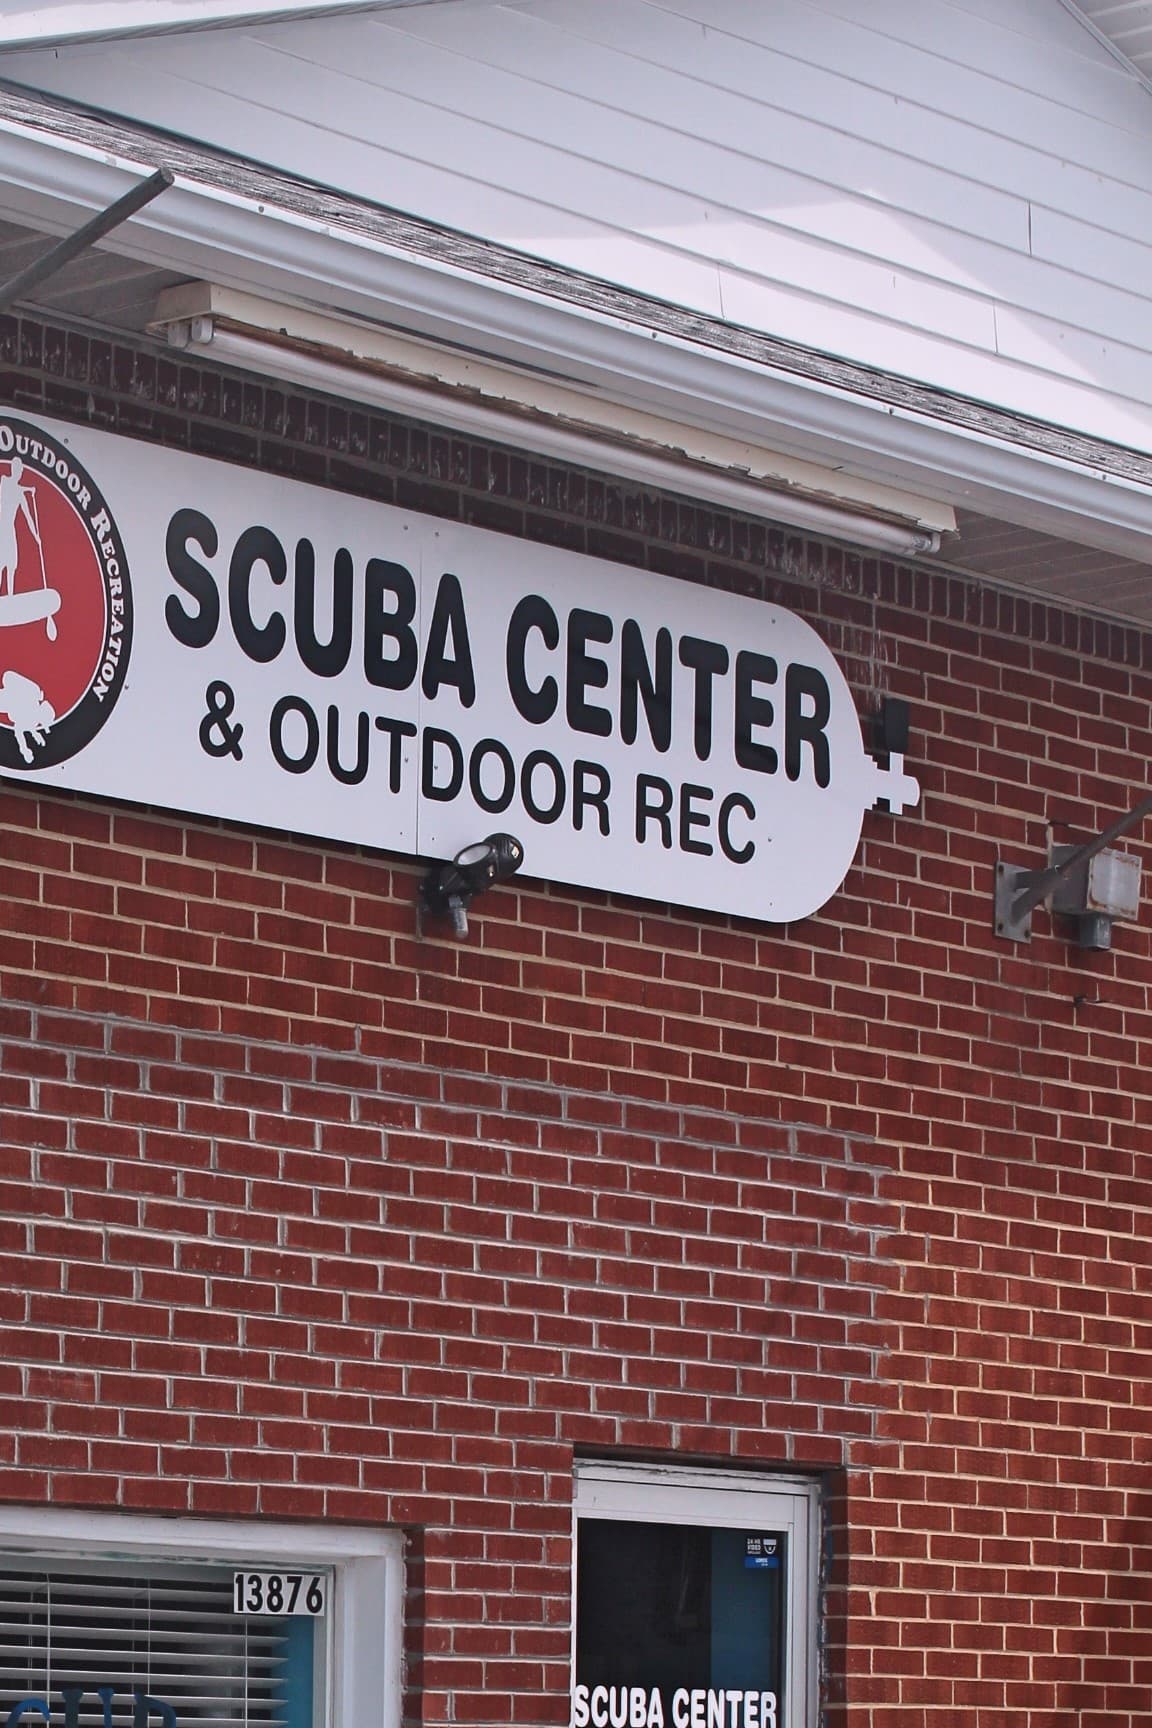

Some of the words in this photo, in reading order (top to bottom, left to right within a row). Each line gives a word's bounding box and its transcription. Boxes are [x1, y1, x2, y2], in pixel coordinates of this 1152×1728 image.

[91, 507, 125, 702] RECREATION
[164, 507, 477, 709] SCUBA
[506, 594, 831, 789] CENTER
[198, 679, 244, 762] &
[269, 694, 612, 837] OUTDOOR
[634, 772, 756, 865] REC
[235, 1573, 323, 1614] 13876
